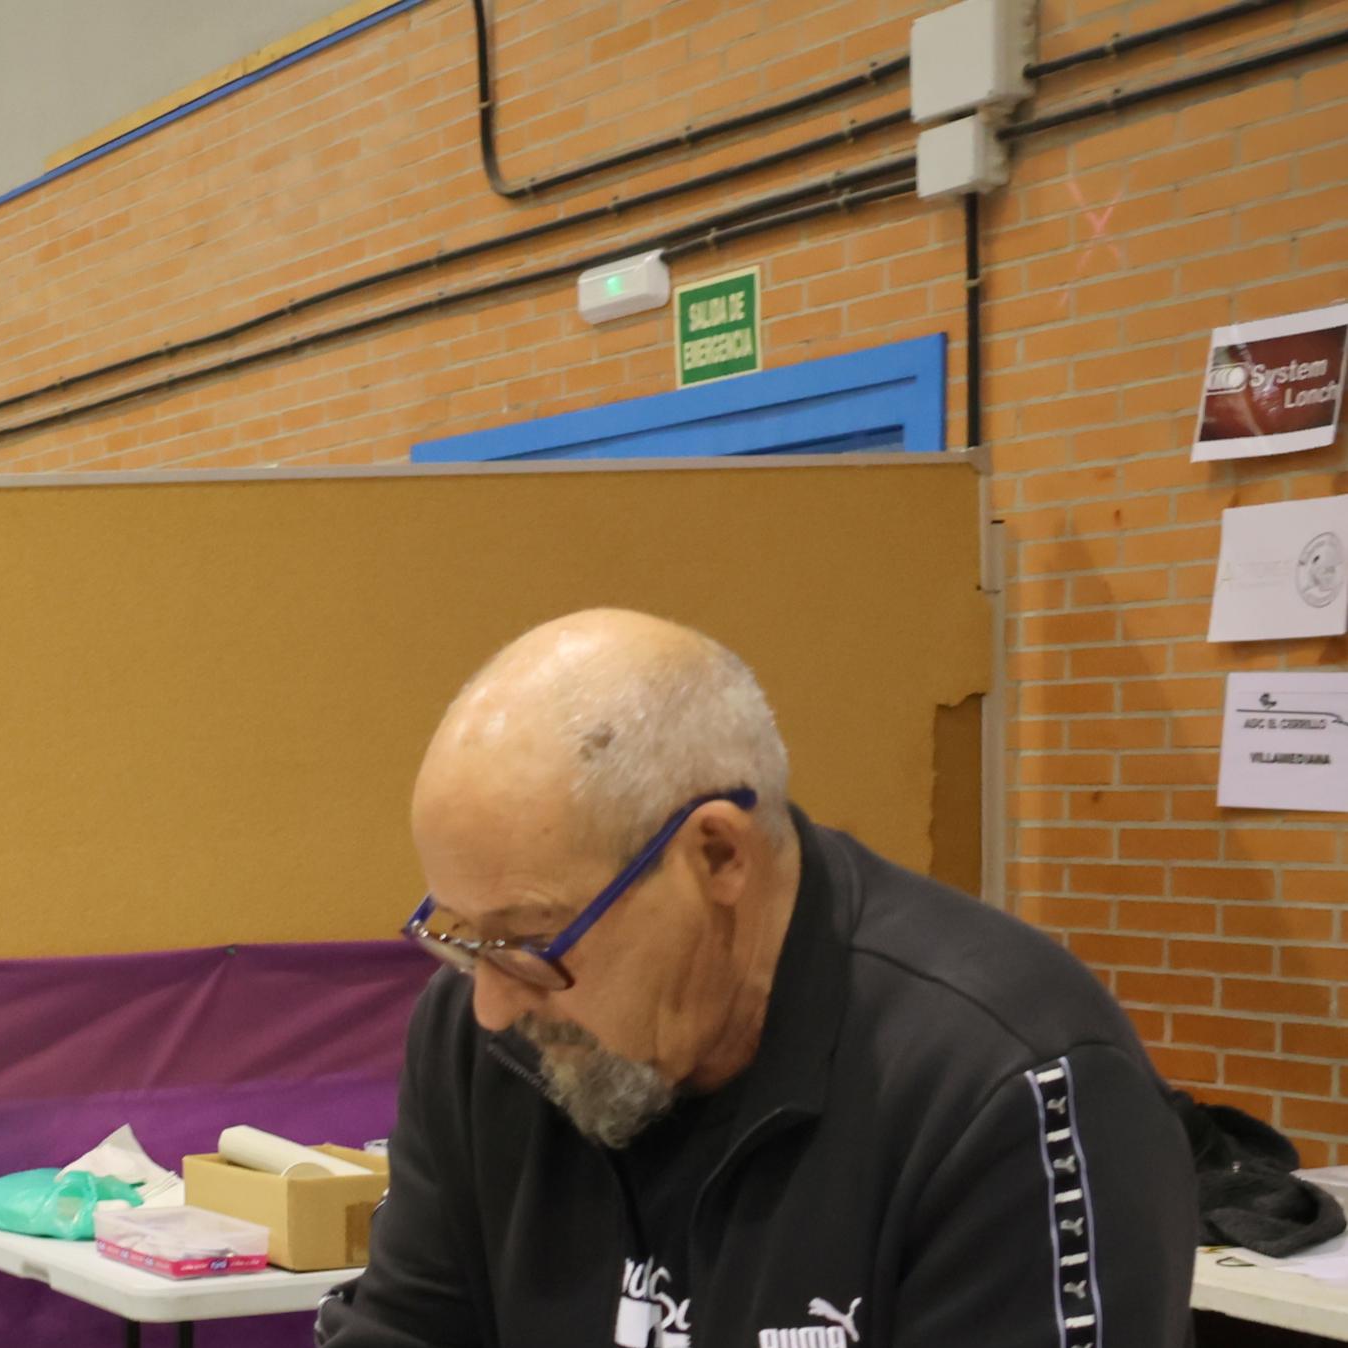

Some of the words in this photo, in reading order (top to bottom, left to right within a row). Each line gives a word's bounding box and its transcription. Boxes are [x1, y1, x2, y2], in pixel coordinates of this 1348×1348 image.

[689, 295, 727, 332] SALIDA
[728, 290, 746, 322] DE
[684, 327, 754, 370] EMERGENCIA
[1249, 359, 1328, 391] System
